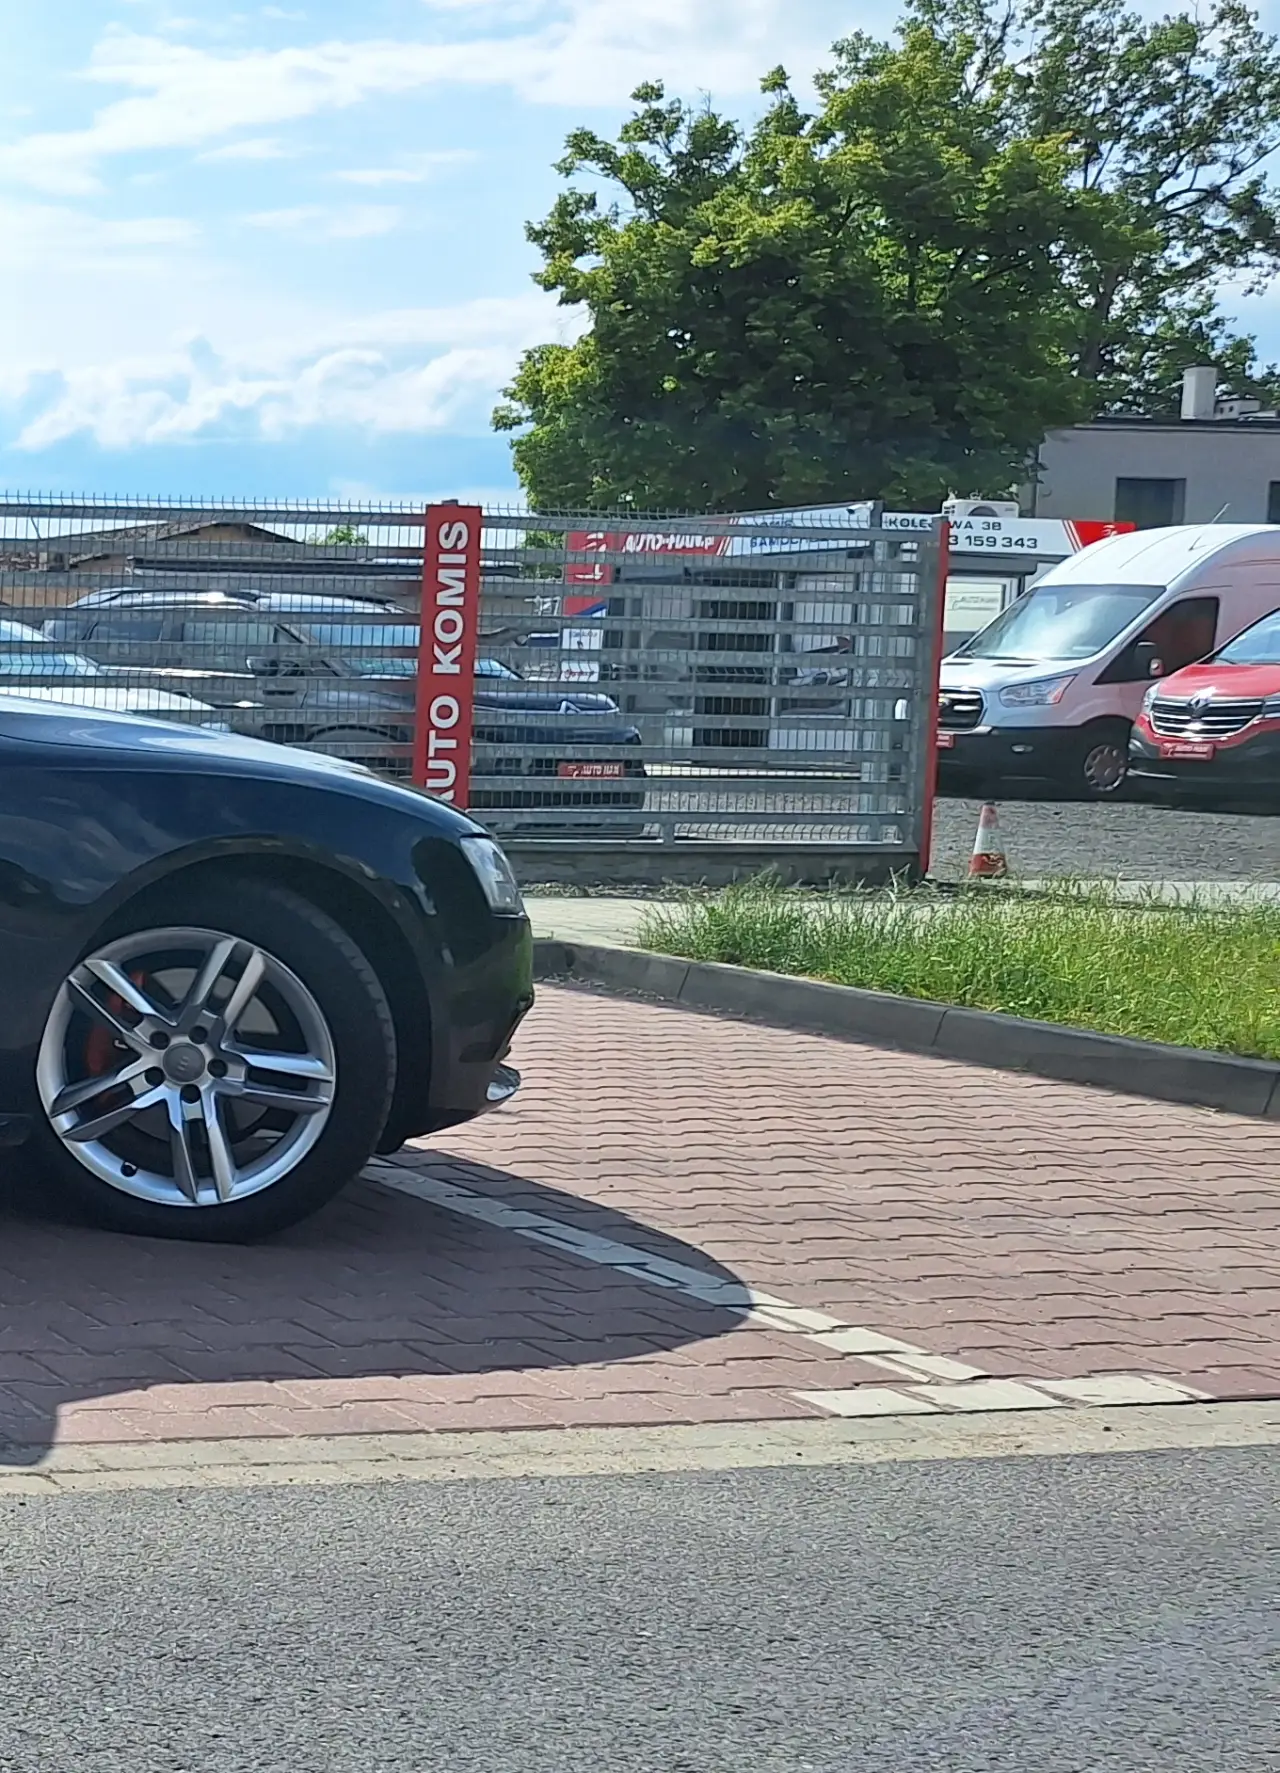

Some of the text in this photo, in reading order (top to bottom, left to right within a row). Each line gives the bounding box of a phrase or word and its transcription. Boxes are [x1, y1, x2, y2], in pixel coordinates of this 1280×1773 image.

[965, 534, 997, 548] 159
[1001, 536, 1038, 549] 343
[432, 520, 469, 674] KOMIS
